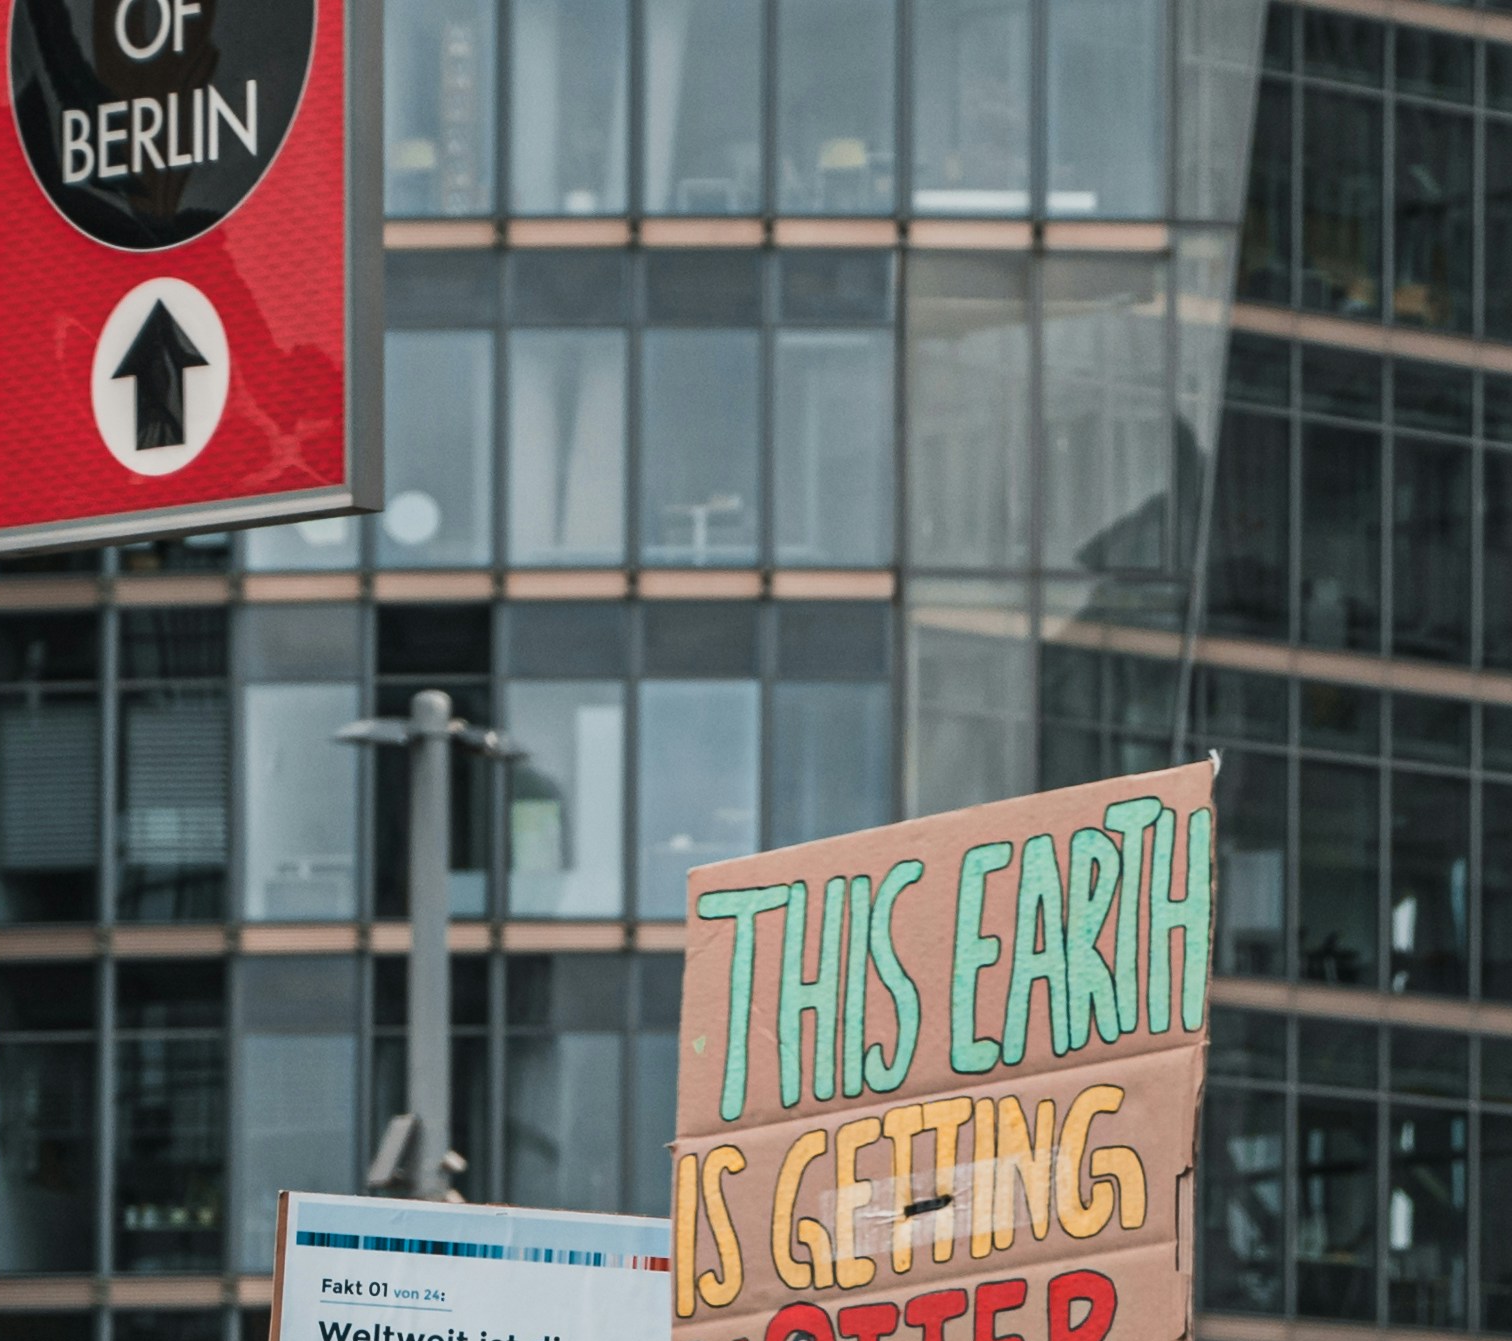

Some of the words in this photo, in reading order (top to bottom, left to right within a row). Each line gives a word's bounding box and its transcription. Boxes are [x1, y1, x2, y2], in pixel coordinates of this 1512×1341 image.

[114, 0, 202, 60] OF
[61, 78, 258, 185] BERLIN
[696, 858, 925, 1123] THIS
[949, 795, 1213, 1075] EARTH
[675, 1143, 747, 1319] IS
[770, 1083, 1148, 1291] GETTING
[321, 1278, 363, 1296] Fakt
[368, 1281, 389, 1298] 01
[393, 1286, 420, 1300] von
